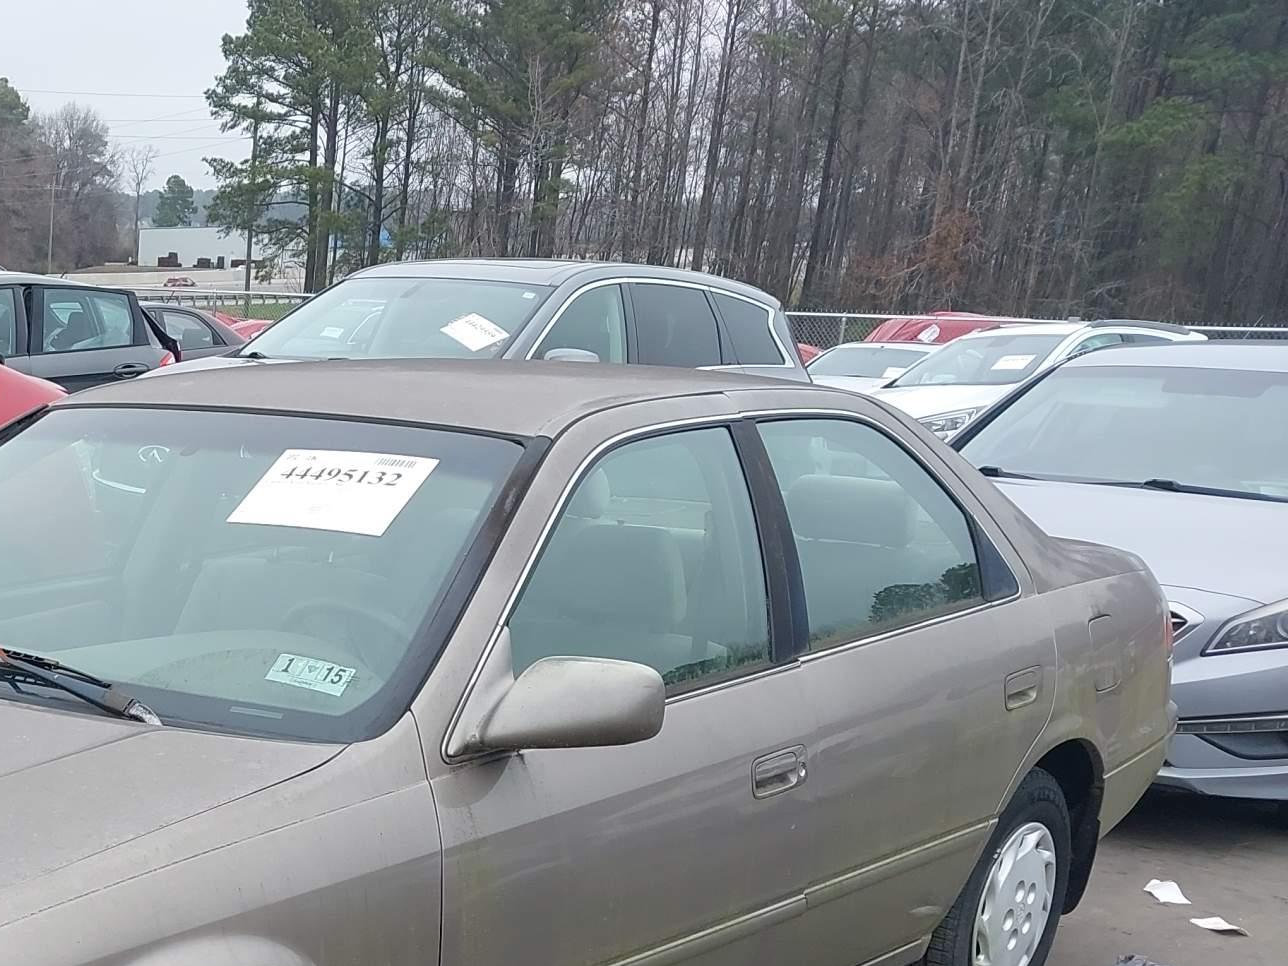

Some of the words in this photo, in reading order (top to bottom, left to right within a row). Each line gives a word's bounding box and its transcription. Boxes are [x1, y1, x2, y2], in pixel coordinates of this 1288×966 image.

[280, 465, 402, 486] 44495132
[281, 658, 295, 673] 1
[322, 666, 347, 684] 15
